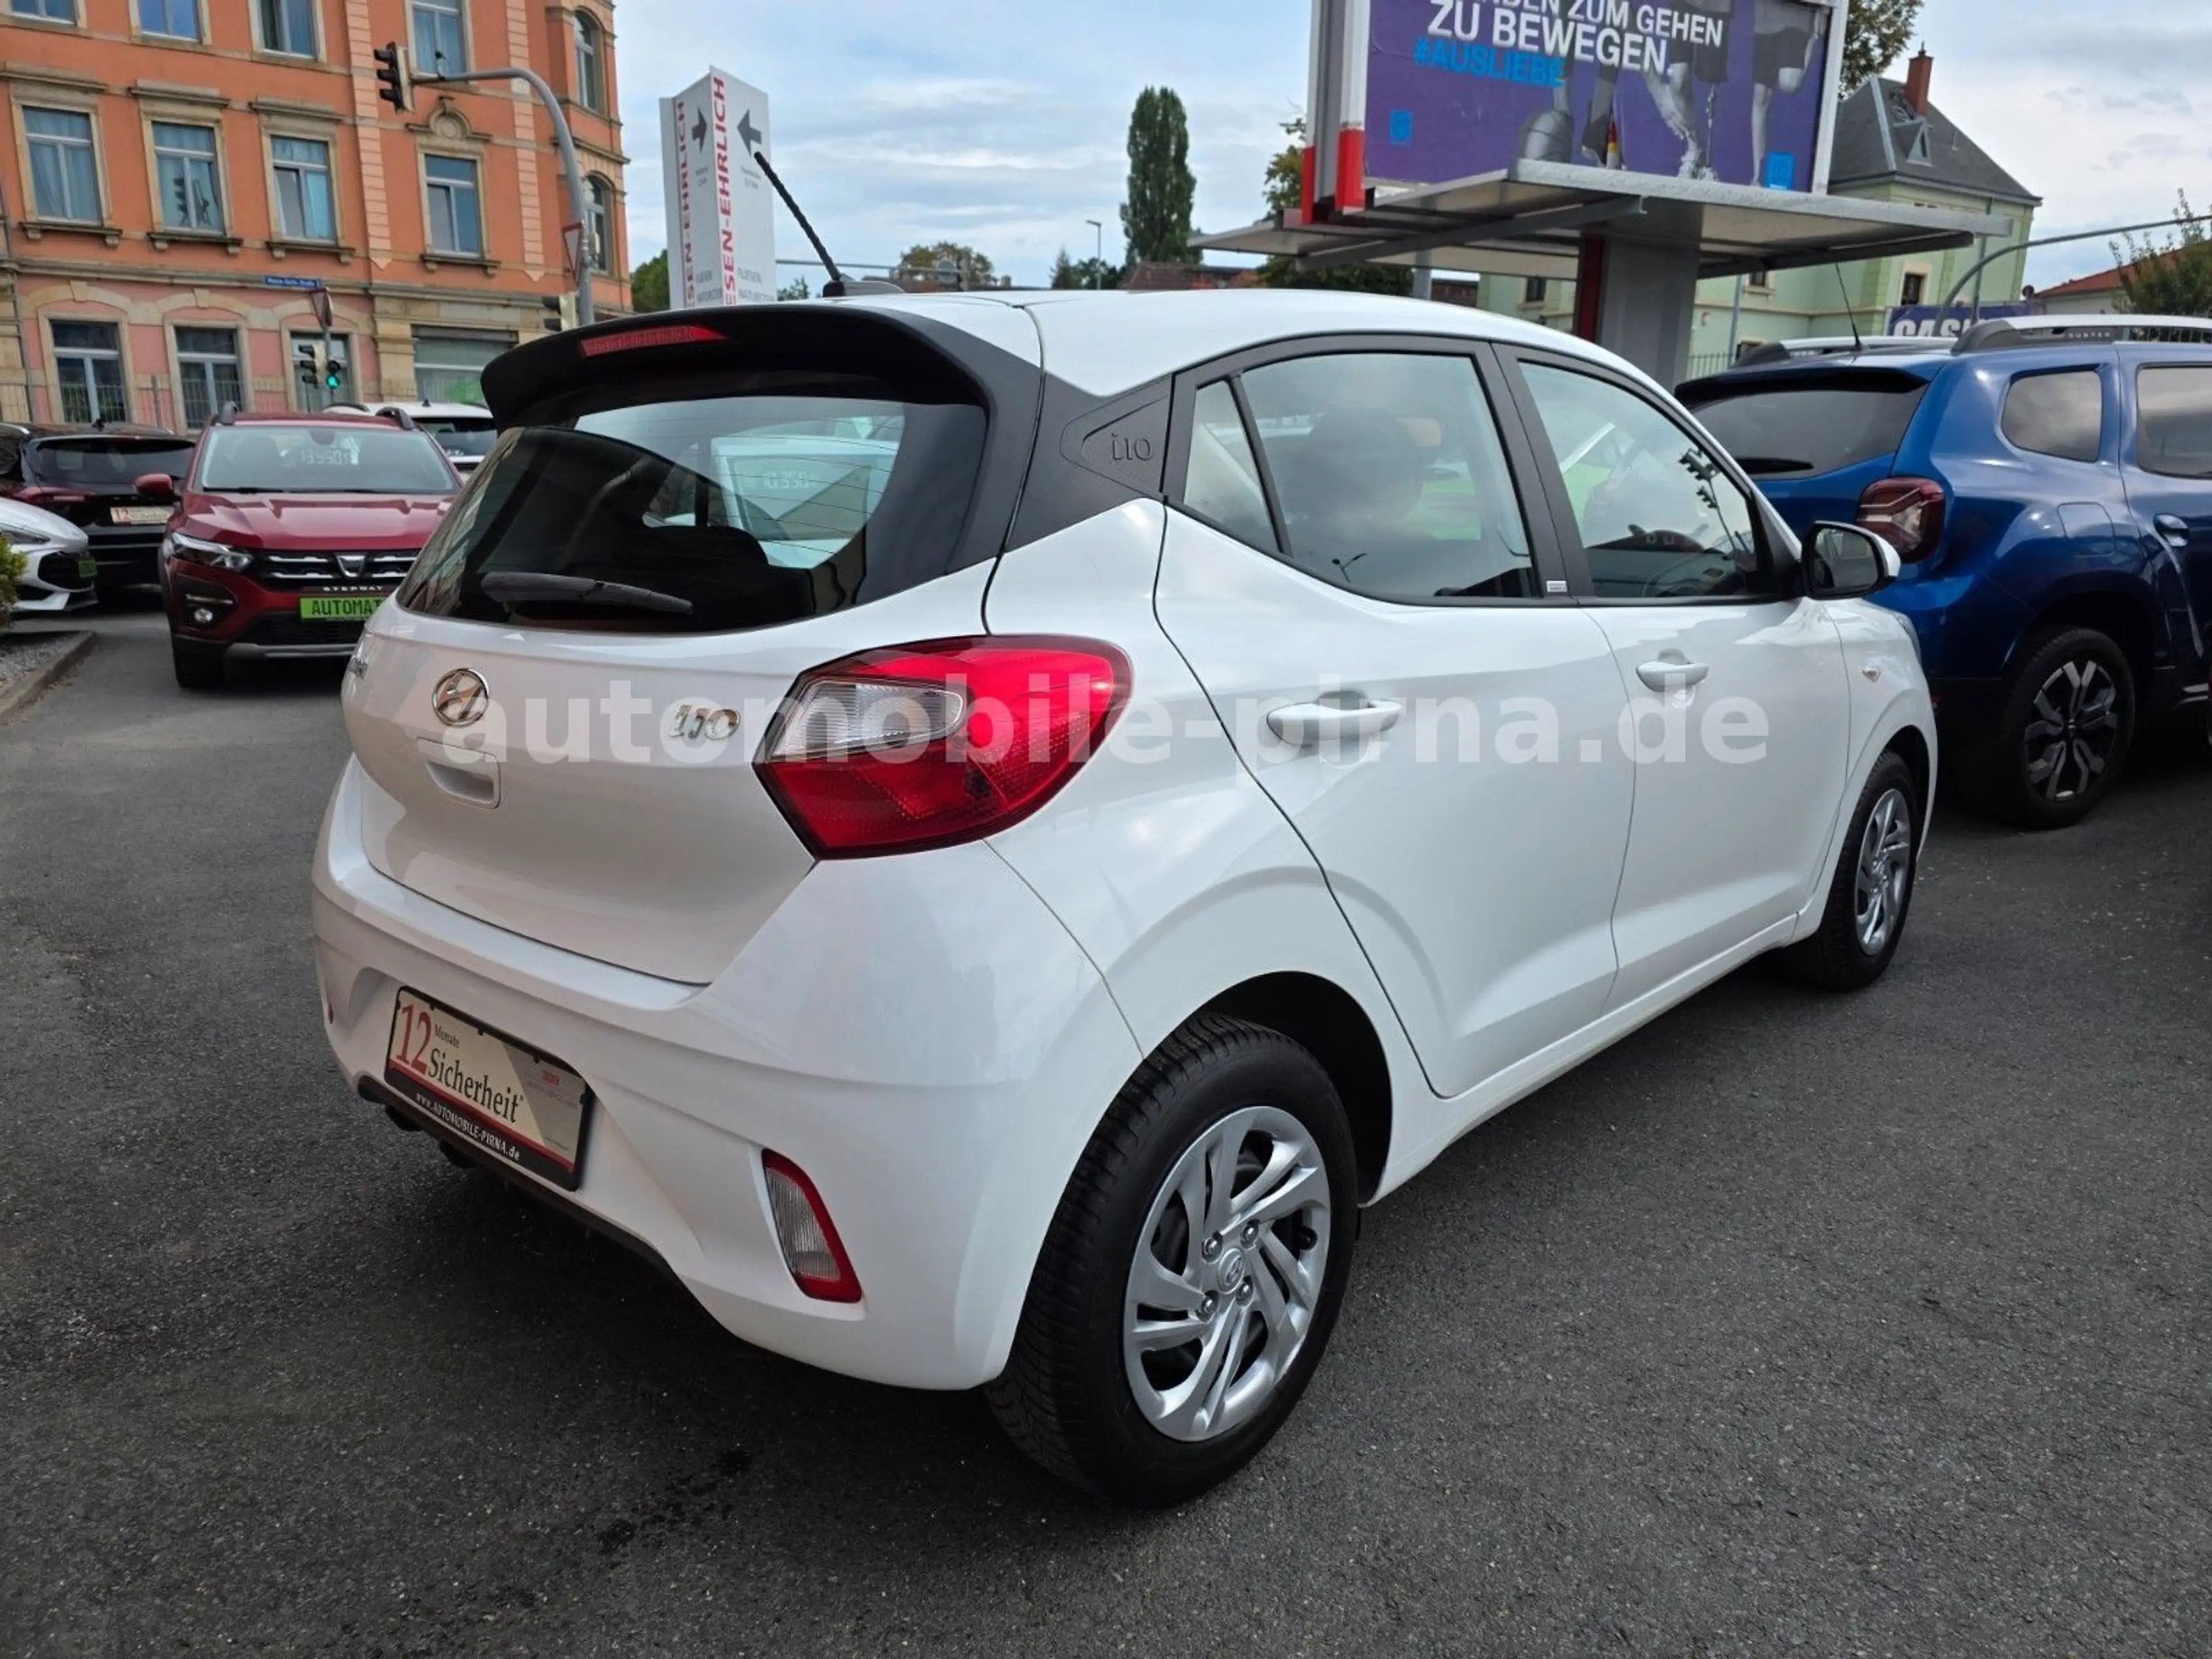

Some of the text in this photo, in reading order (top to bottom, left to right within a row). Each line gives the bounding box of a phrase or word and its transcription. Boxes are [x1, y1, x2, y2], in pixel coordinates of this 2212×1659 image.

[1427, 0, 1673, 76] ZU BEWEGEN.
[1567, 0, 1629, 29] ZUM
[1636, 5, 1723, 47] GEHEN
[1414, 36, 1566, 88] #AUSLIEBE
[1111, 433, 1152, 461] i10
[396, 1003, 431, 1075] 12
[428, 1047, 519, 1123] Sicherheit
